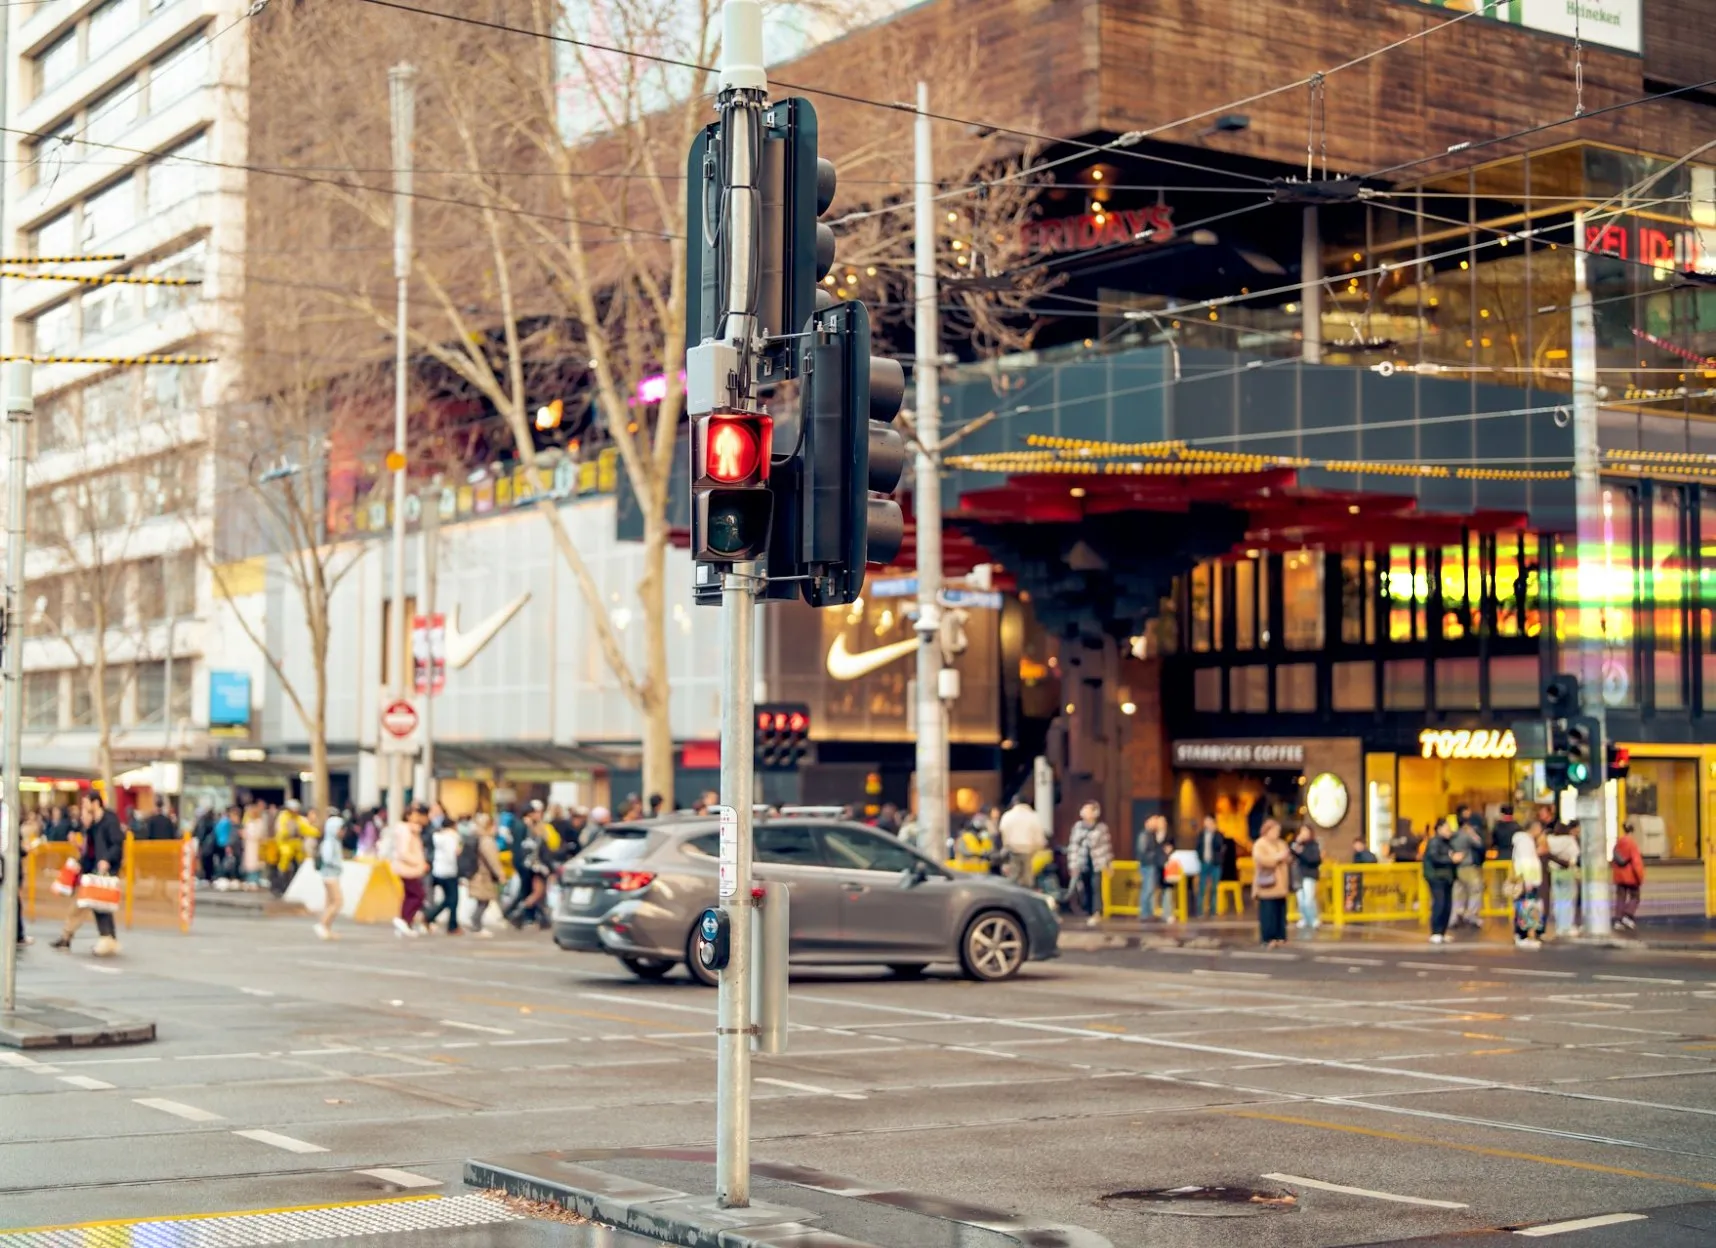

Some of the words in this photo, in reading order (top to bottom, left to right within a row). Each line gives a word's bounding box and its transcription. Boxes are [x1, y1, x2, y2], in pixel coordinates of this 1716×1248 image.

[1566, 1, 1620, 26] Heineken
[1177, 744, 1251, 761] STARBUCKS
[1253, 744, 1304, 761] COFFEE
